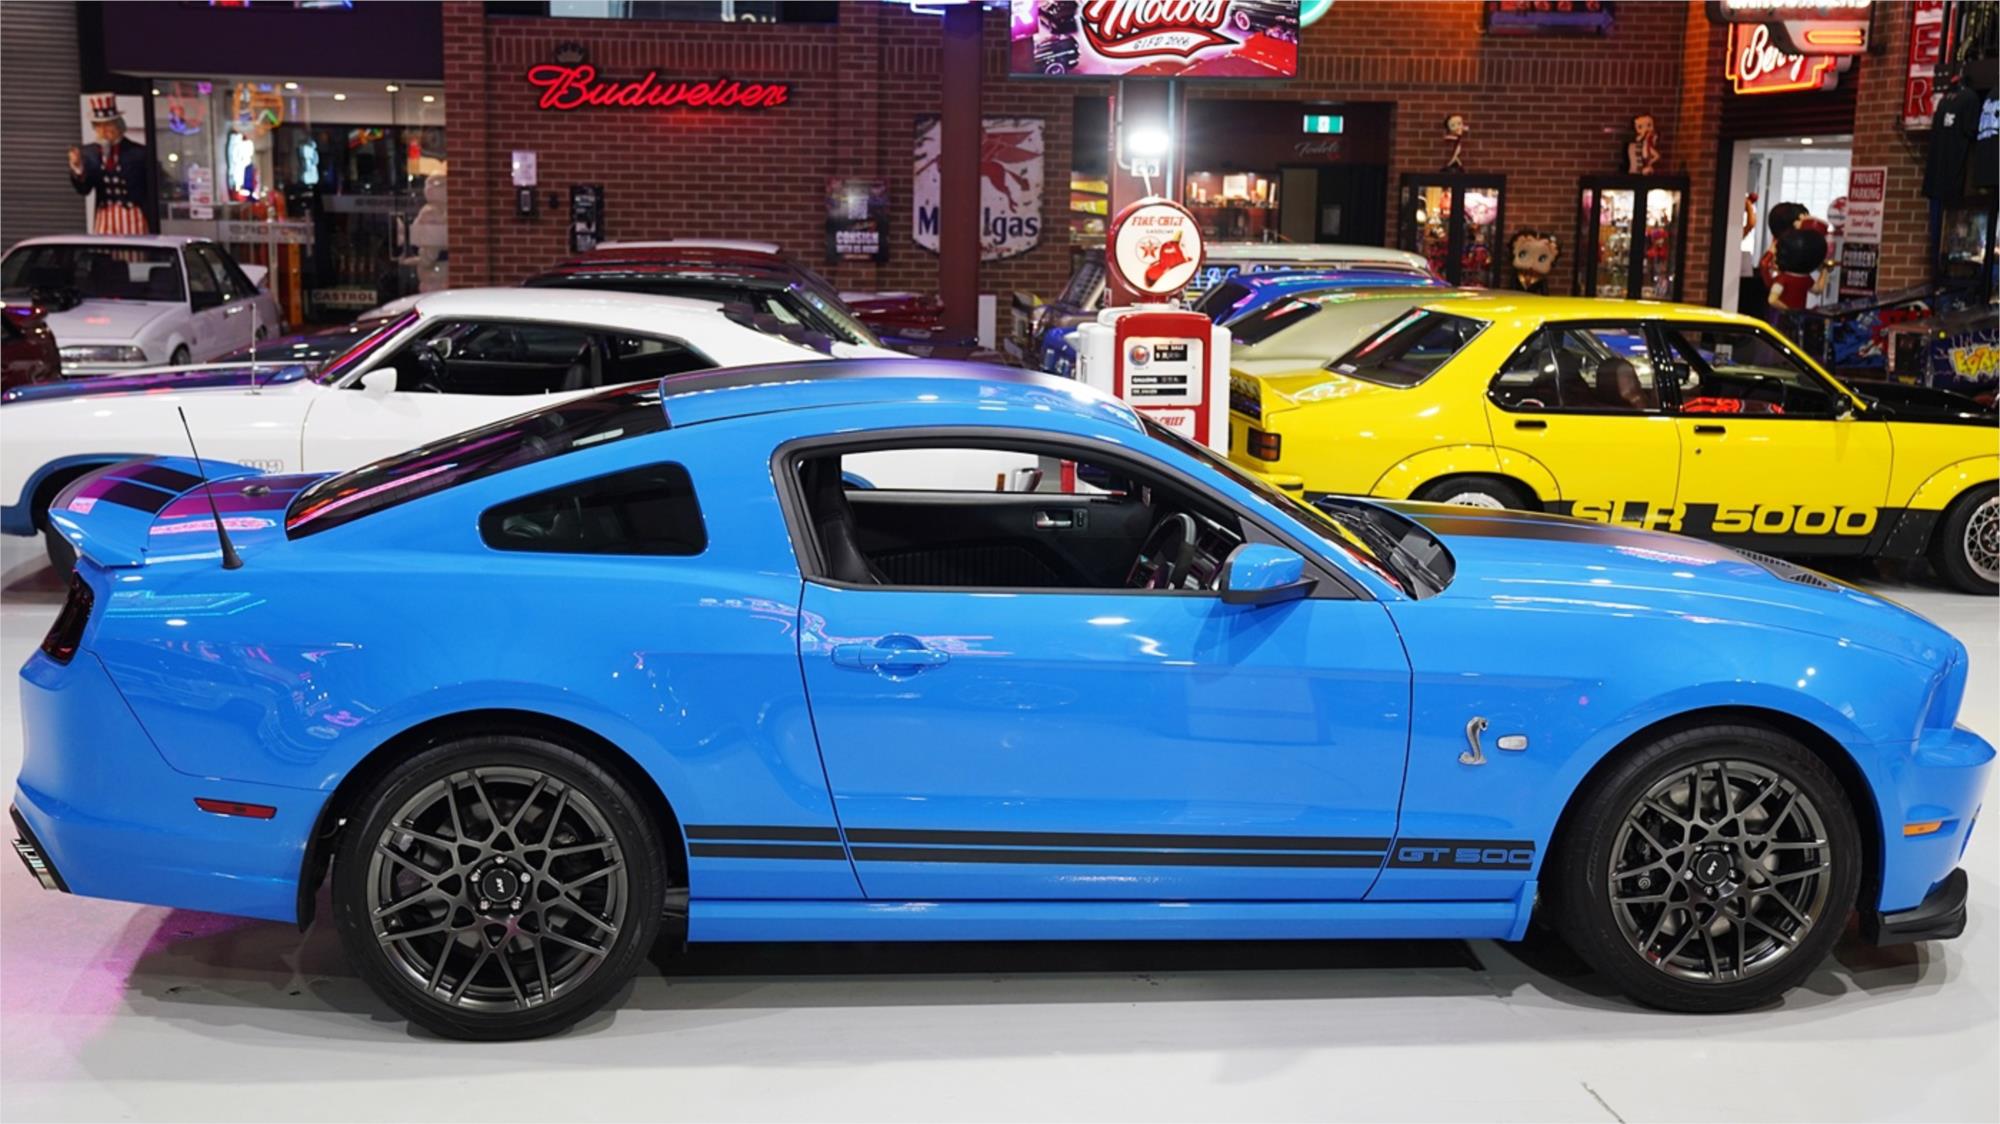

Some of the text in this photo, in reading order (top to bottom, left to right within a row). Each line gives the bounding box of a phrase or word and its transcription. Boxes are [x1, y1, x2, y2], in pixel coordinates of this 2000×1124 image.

[528, 65, 788, 109] Budweiser
[918, 206, 1038, 245] Mlgas
[1842, 251, 1876, 268] CURRENT
[315, 292, 374, 302] CASTROL
[1571, 500, 1878, 535] SLR 5000
[1398, 846, 1536, 864] GT 500
